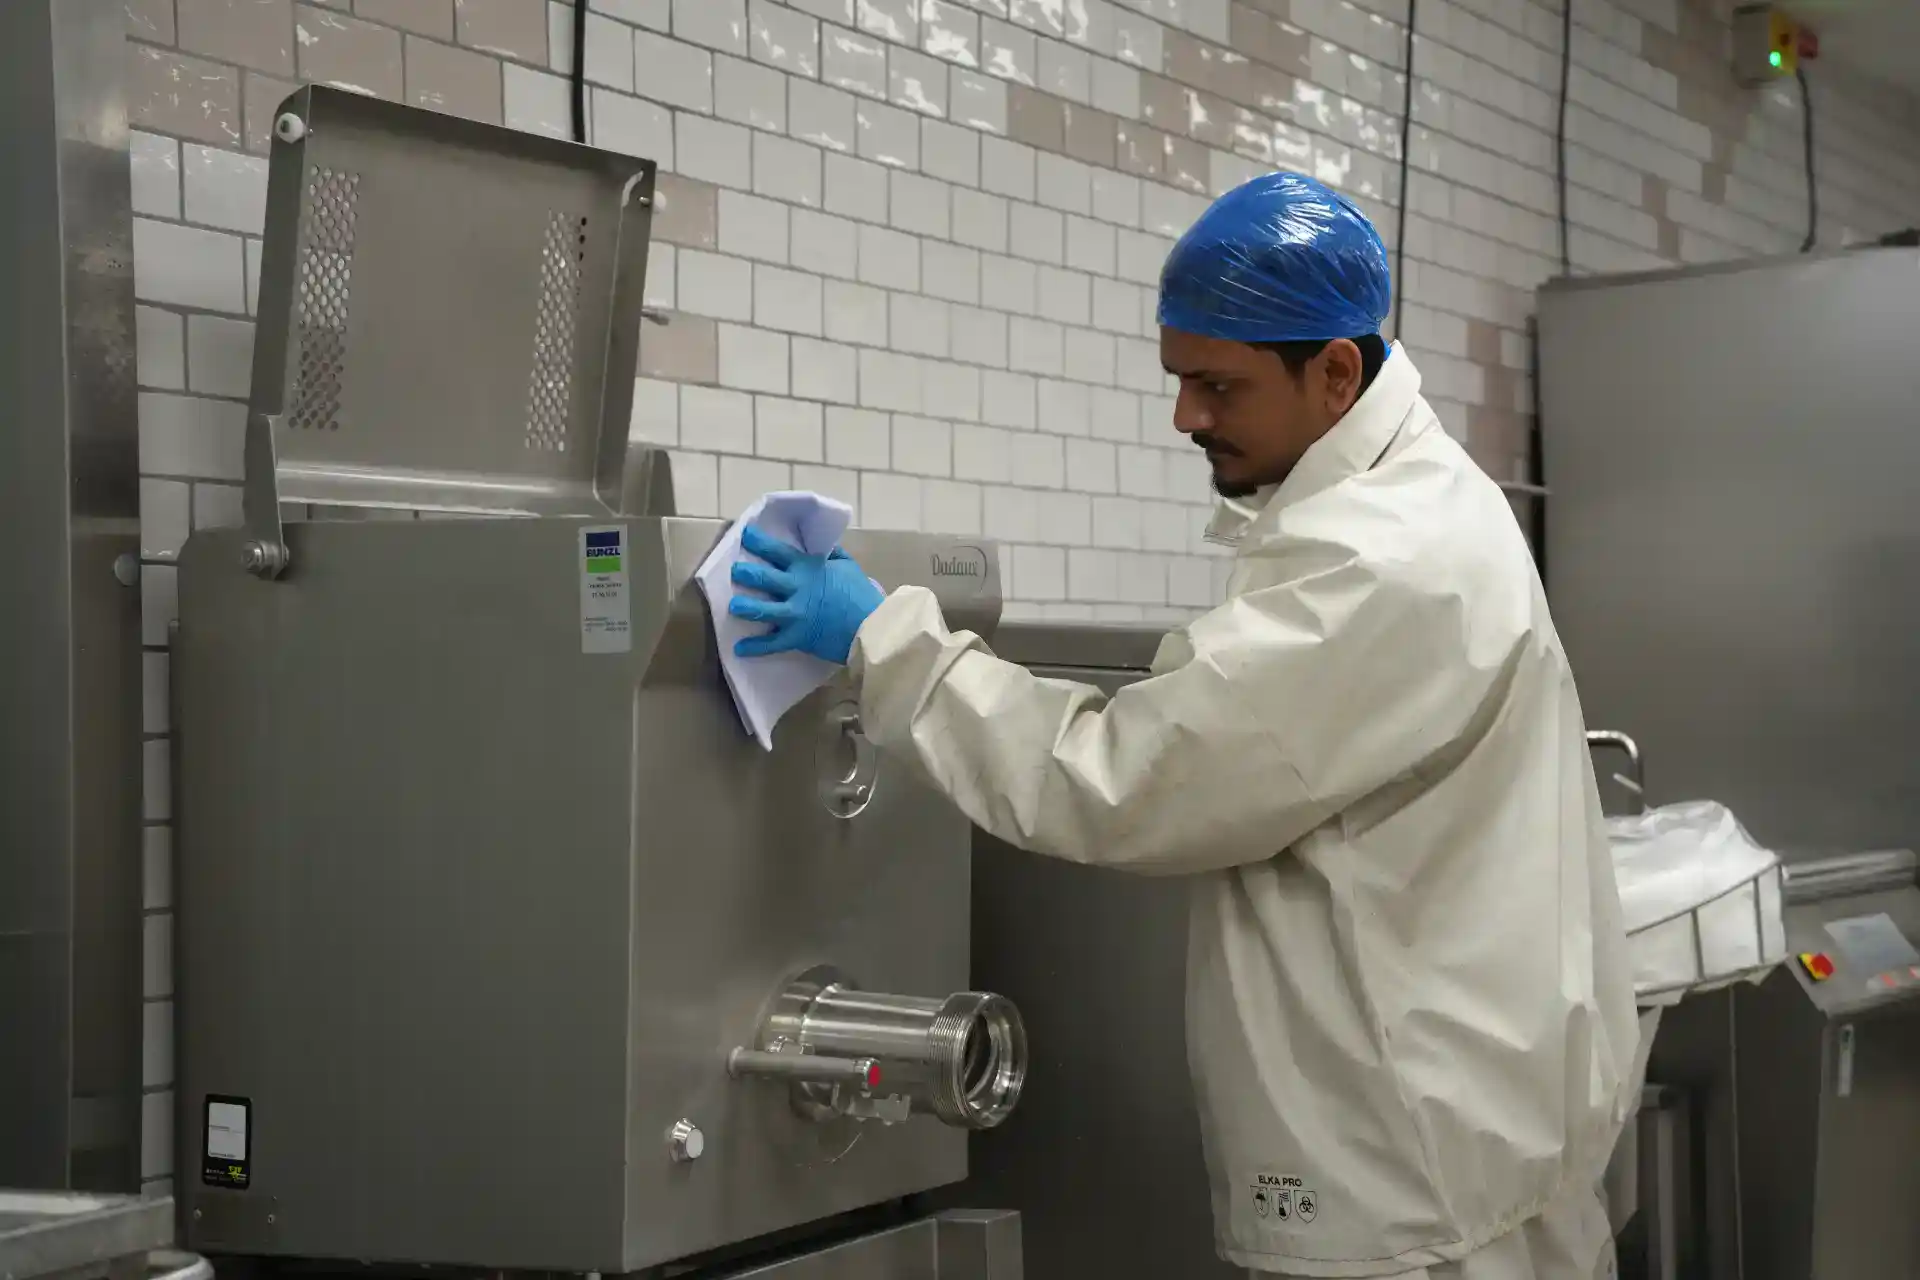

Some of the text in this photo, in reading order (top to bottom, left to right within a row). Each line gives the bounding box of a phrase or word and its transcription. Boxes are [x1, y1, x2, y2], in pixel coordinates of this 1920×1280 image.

[586, 547, 621, 558] BUNZL
[1257, 1174, 1303, 1187] ELKA PRO
